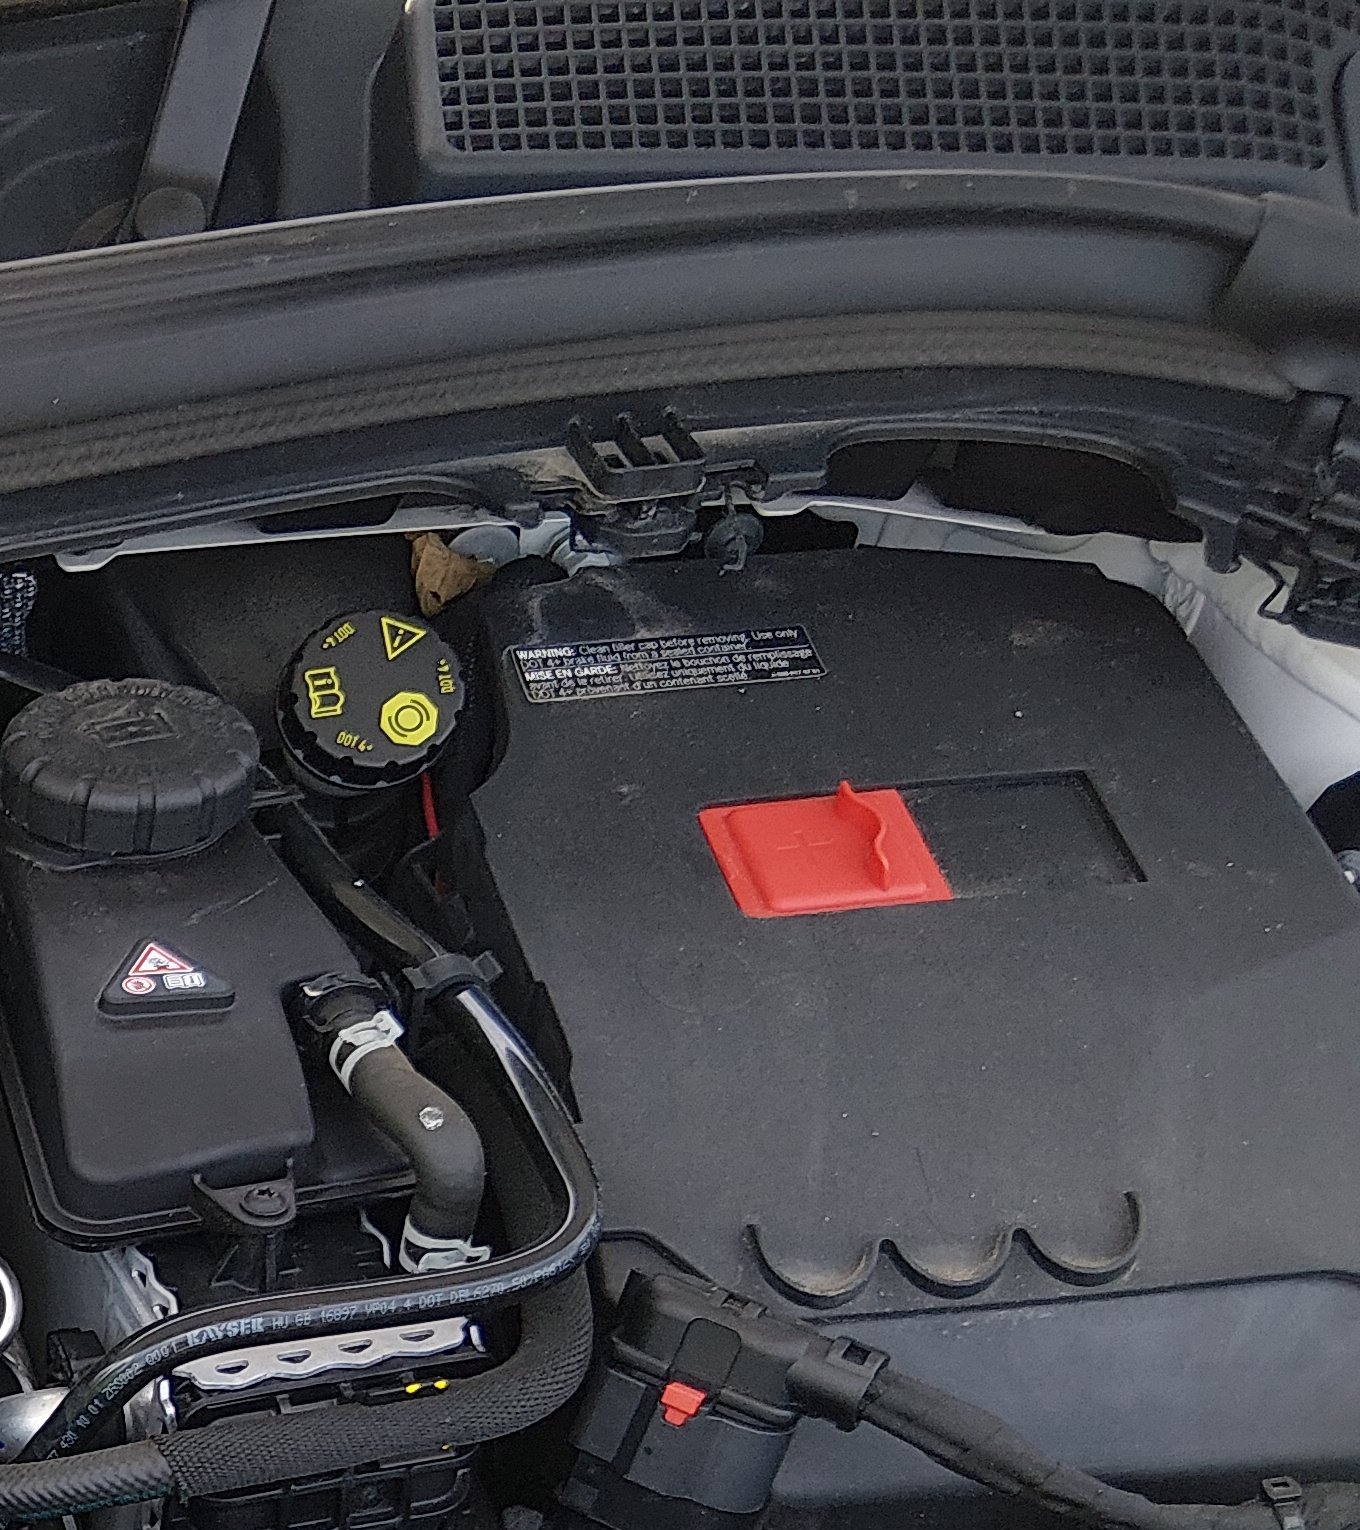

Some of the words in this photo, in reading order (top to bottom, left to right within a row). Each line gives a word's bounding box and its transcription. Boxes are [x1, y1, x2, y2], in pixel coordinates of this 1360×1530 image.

[516, 646, 576, 660] WARNING:
[579, 644, 610, 655] Clean
[775, 628, 798, 639] only
[524, 670, 555, 682] MISE
[555, 668, 573, 679] EN
